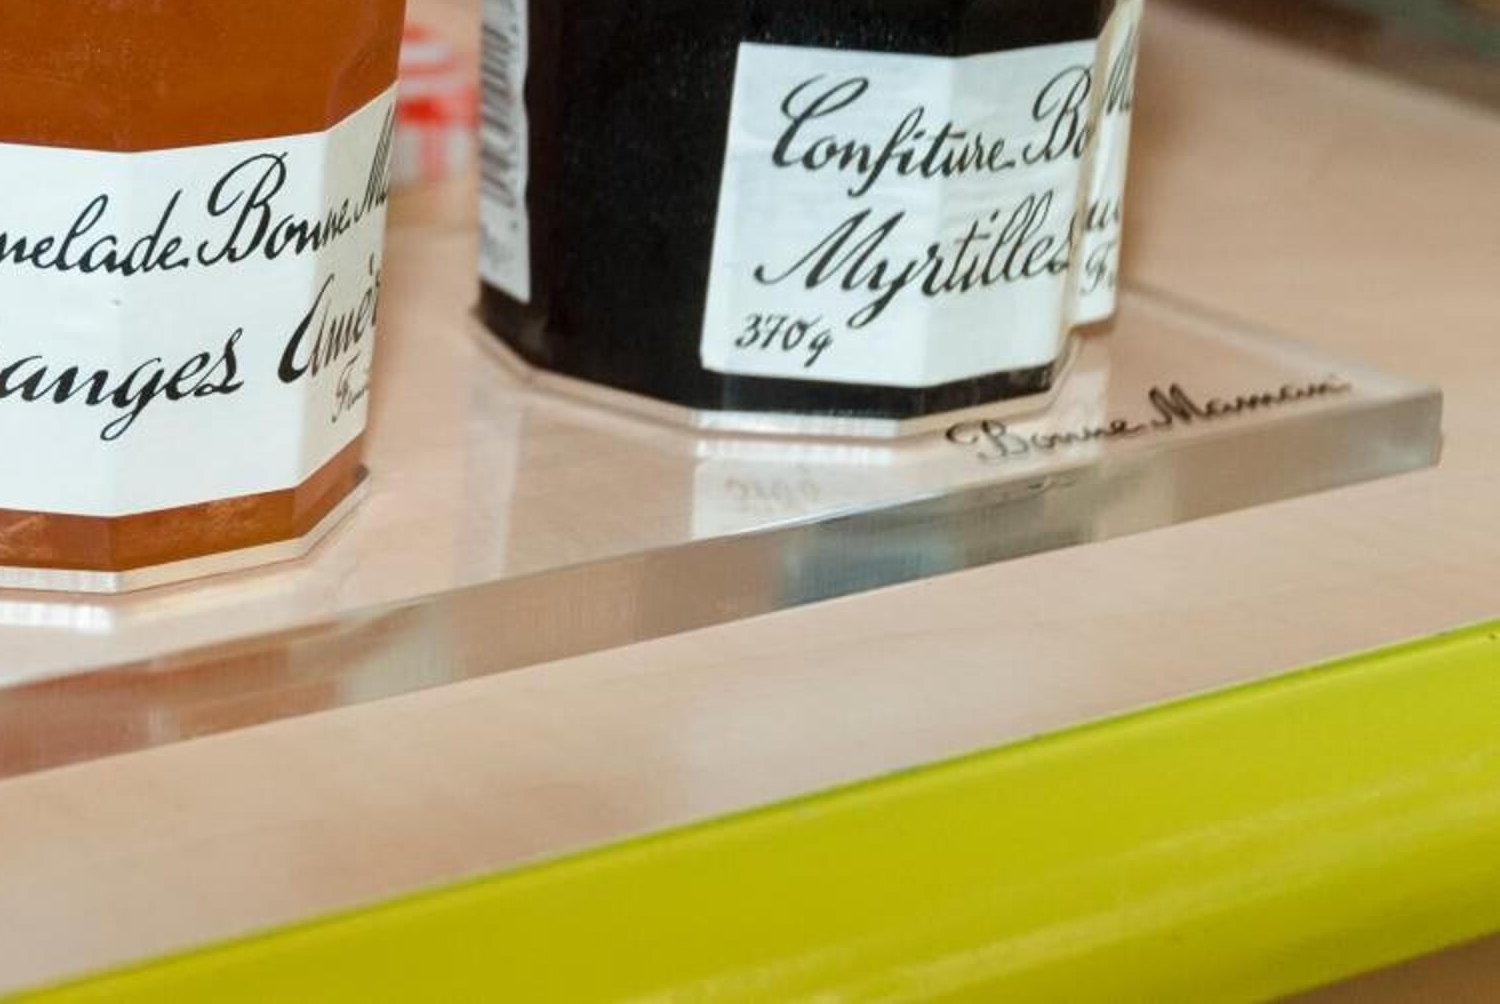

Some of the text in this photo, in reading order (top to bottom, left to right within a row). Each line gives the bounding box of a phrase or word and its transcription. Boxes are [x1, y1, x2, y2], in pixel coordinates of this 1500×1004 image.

[770, 73, 1016, 197] Confiture
[198, 153, 352, 264] Bonne
[753, 188, 1078, 330] Myrtilles
[945, 381, 1353, 464] Bonne Maman
